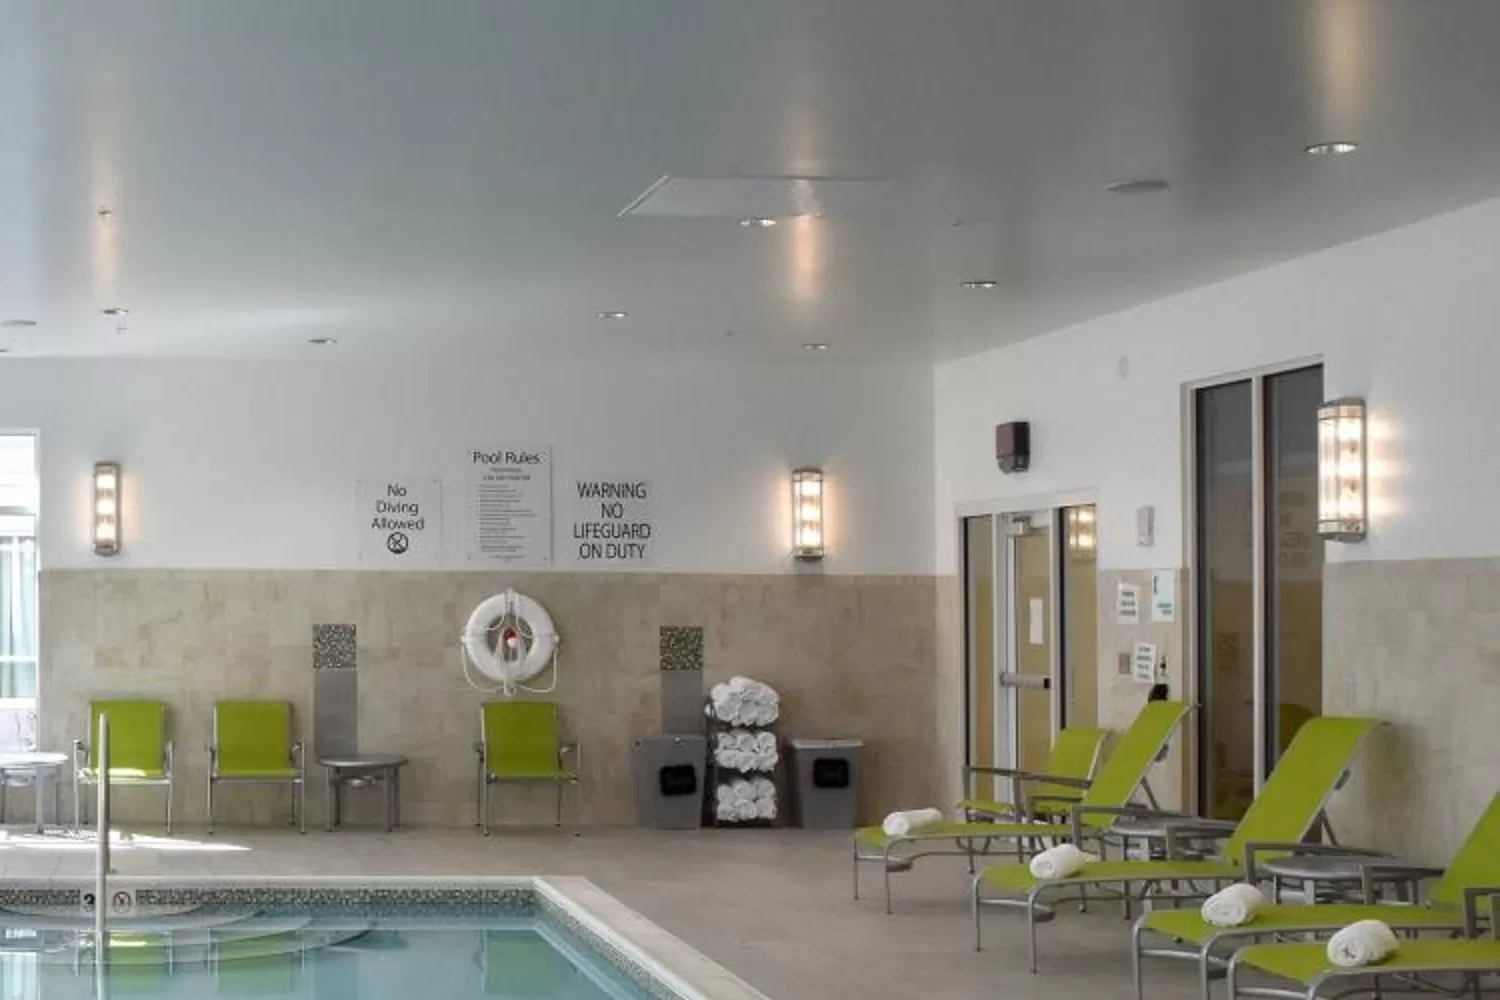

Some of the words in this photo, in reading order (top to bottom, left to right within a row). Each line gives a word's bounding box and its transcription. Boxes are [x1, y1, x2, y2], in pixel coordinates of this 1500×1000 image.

[473, 450, 501, 465] Pool
[505, 450, 540, 465] Rules
[387, 483, 407, 497] No
[577, 482, 647, 499] WARNING
[376, 499, 419, 516] Diving
[602, 502, 624, 519] NO
[371, 516, 425, 531] Allowed
[573, 523, 651, 539] LIFEGUARD
[579, 542, 602, 560] ON
[605, 542, 646, 560] DUTY
